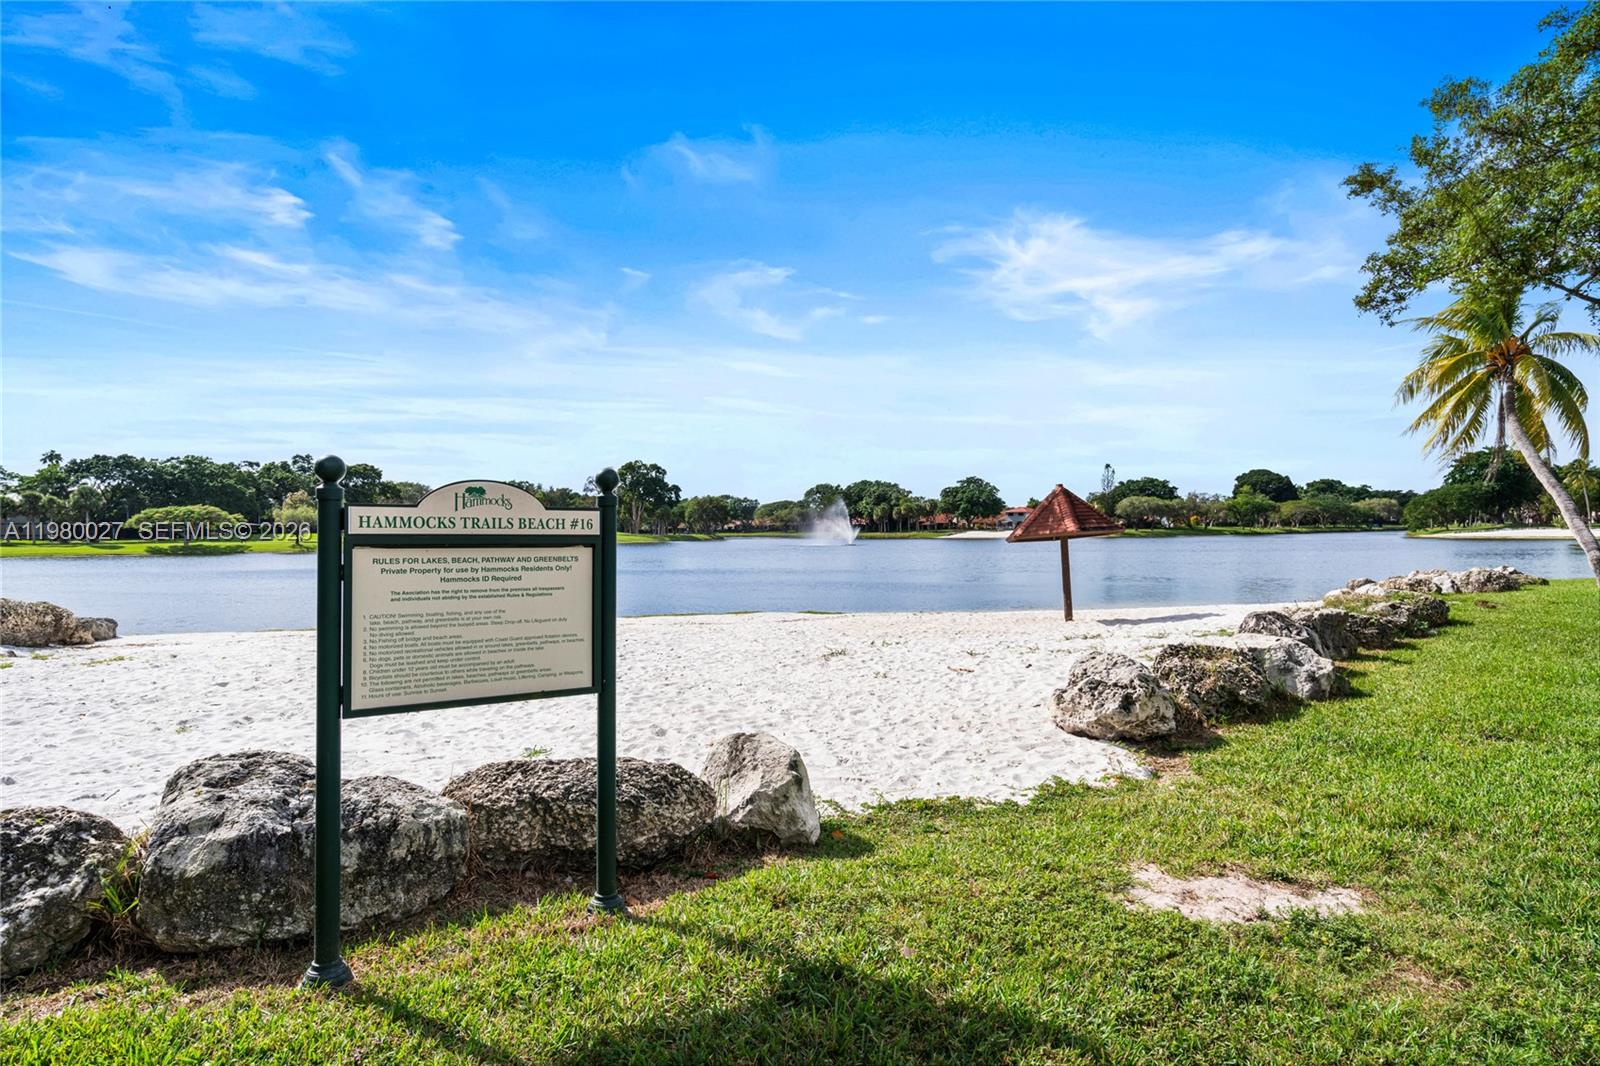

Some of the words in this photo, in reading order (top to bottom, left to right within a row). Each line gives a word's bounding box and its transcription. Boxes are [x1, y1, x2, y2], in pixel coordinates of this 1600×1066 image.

[455, 491, 513, 512] Hammocks
[358, 515, 456, 529] HAMMOCKS
[461, 516, 514, 530] TRAILS
[519, 518, 565, 530] BEACH
[570, 518, 593, 530] #16
[409, 567, 441, 575] Property
[491, 575, 522, 583] Required
